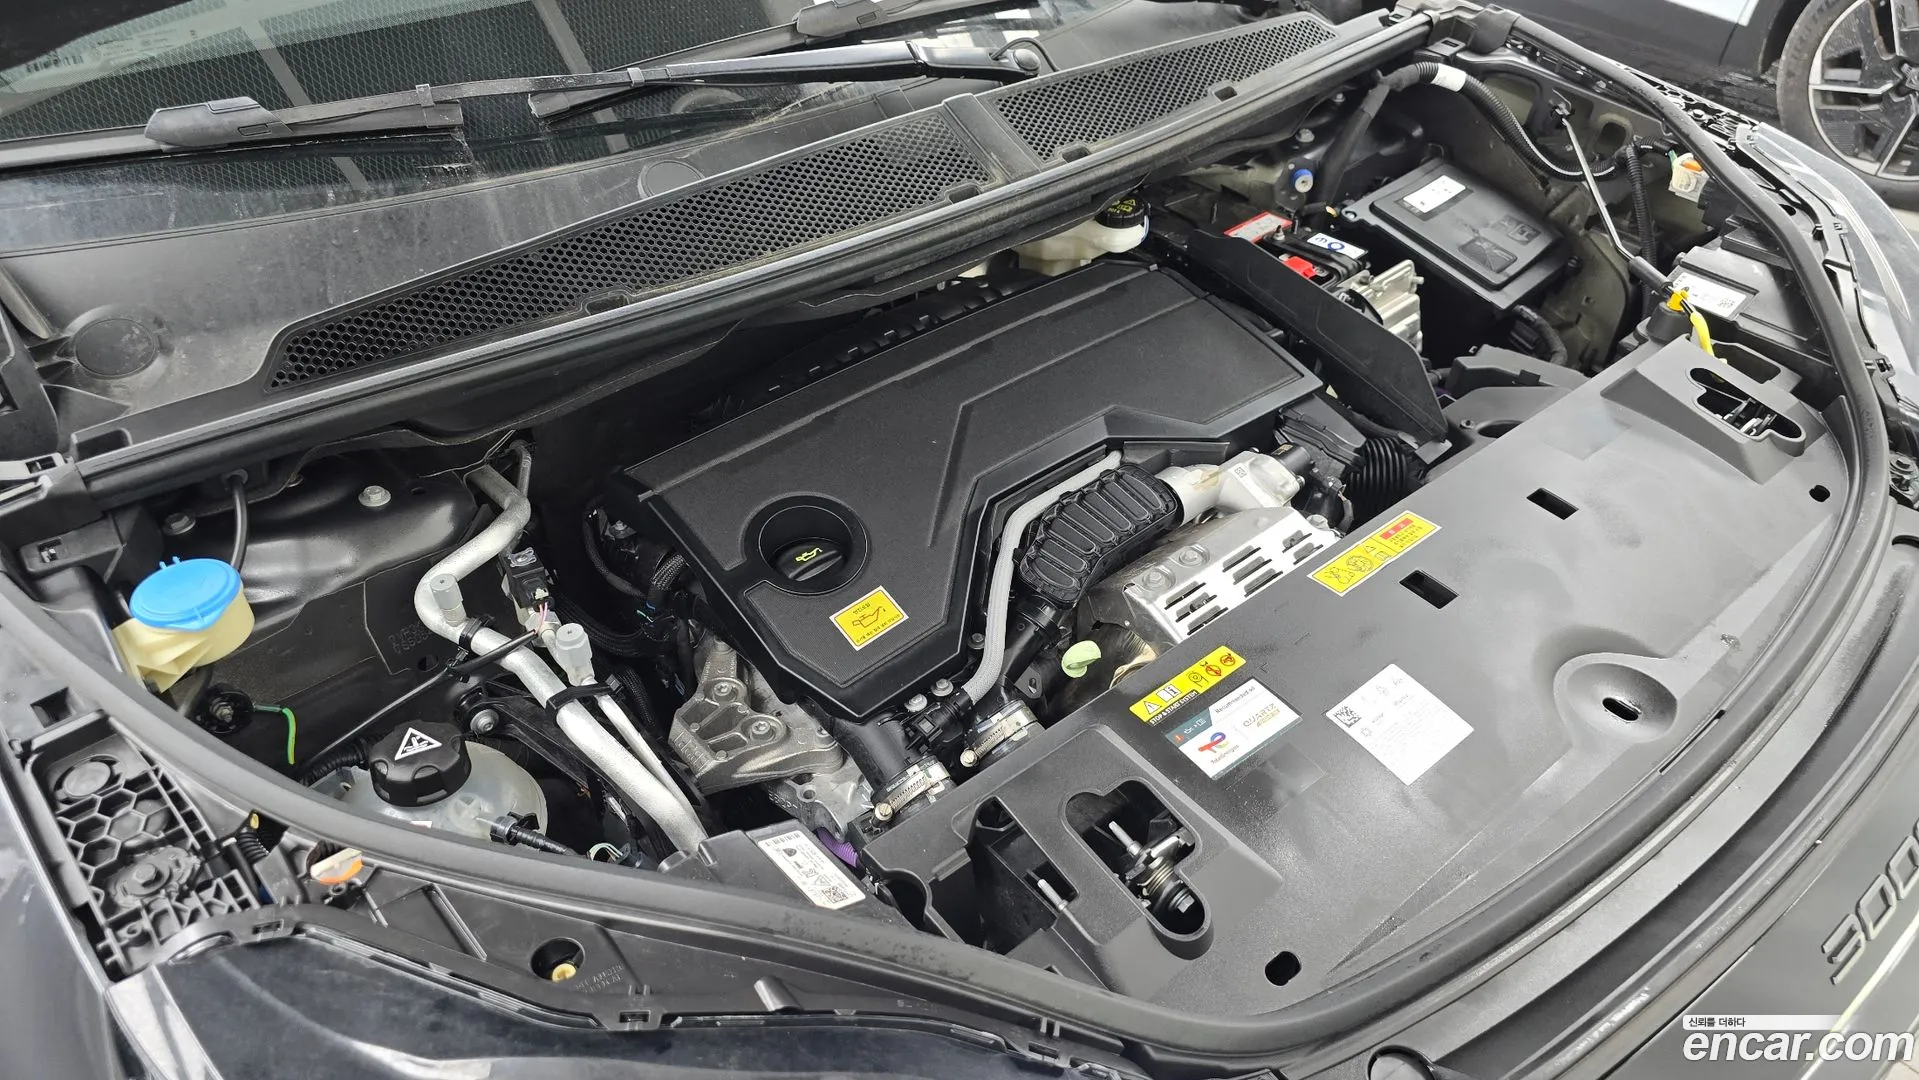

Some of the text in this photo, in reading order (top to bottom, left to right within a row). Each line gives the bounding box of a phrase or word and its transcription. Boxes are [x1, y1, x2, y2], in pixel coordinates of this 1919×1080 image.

[1150, 714, 1163, 725] STOP
[1166, 700, 1181, 714] START
[1242, 702, 1277, 728] QUARTZ
[1820, 817, 1919, 986] 300
